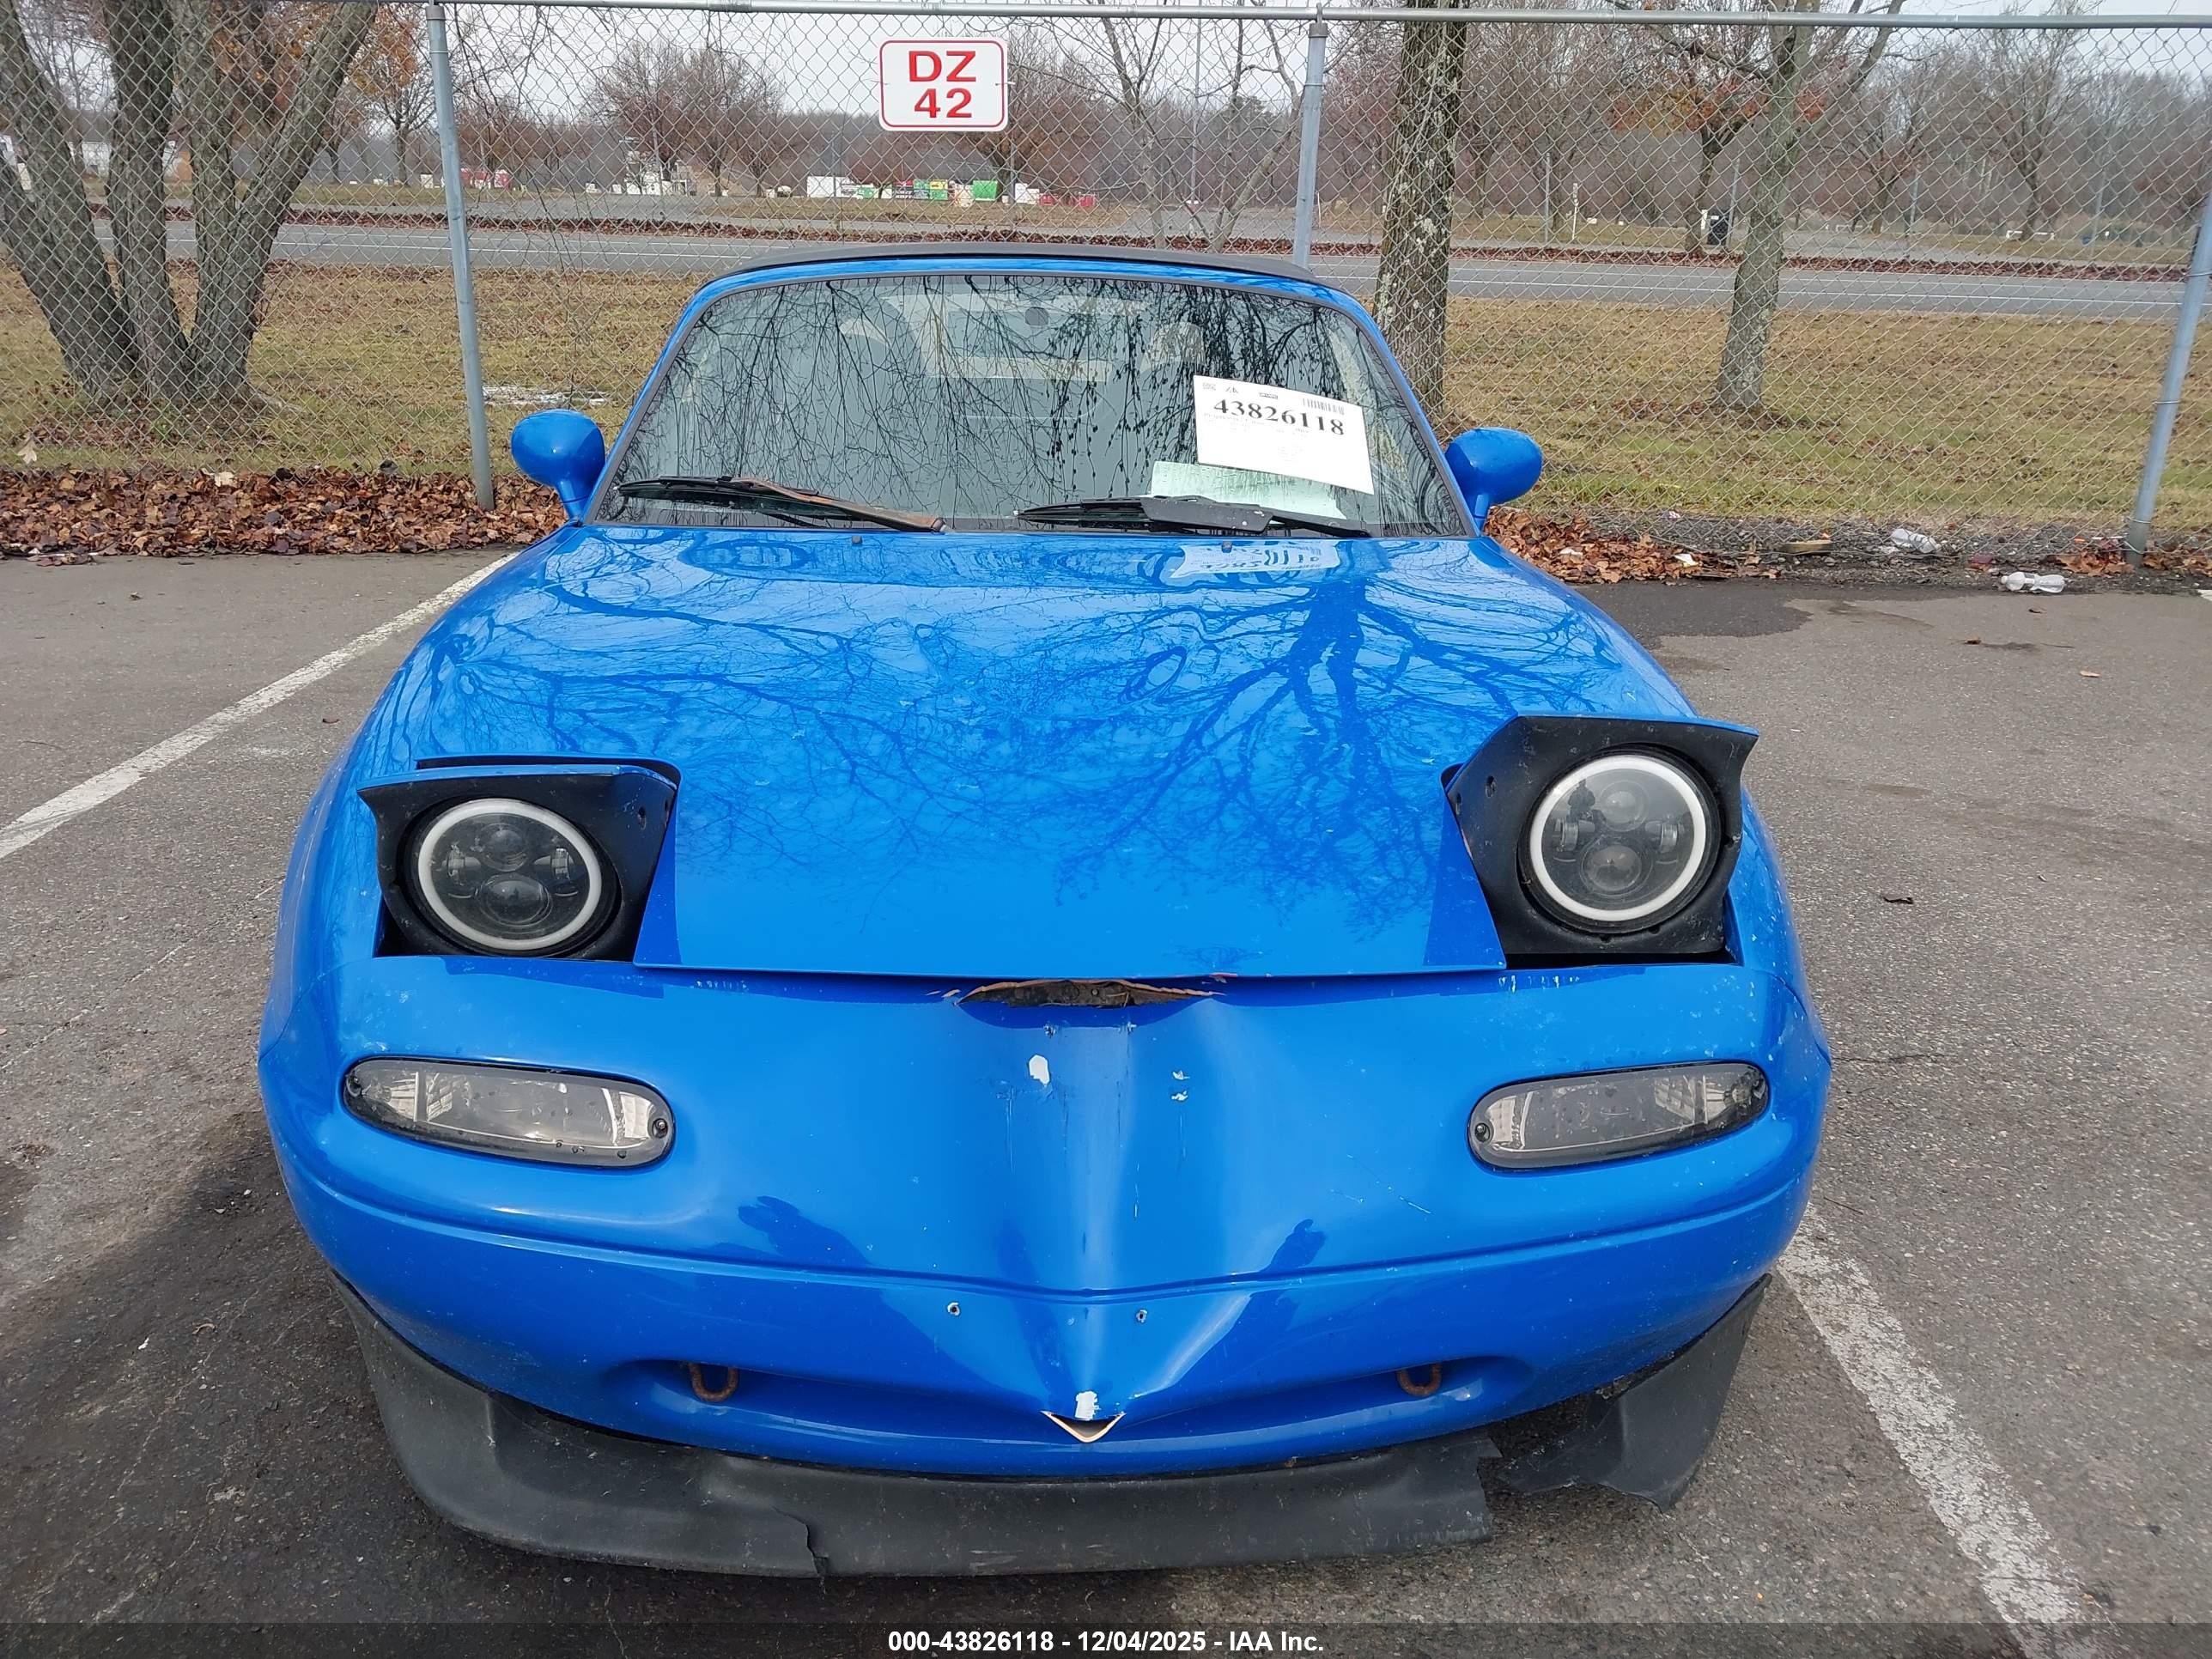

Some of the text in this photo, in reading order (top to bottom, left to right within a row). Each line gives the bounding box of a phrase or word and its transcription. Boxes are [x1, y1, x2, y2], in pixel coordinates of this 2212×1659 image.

[908, 51, 976, 82] DZ
[914, 88, 972, 118] 42
[1213, 398, 1345, 435] 43826118
